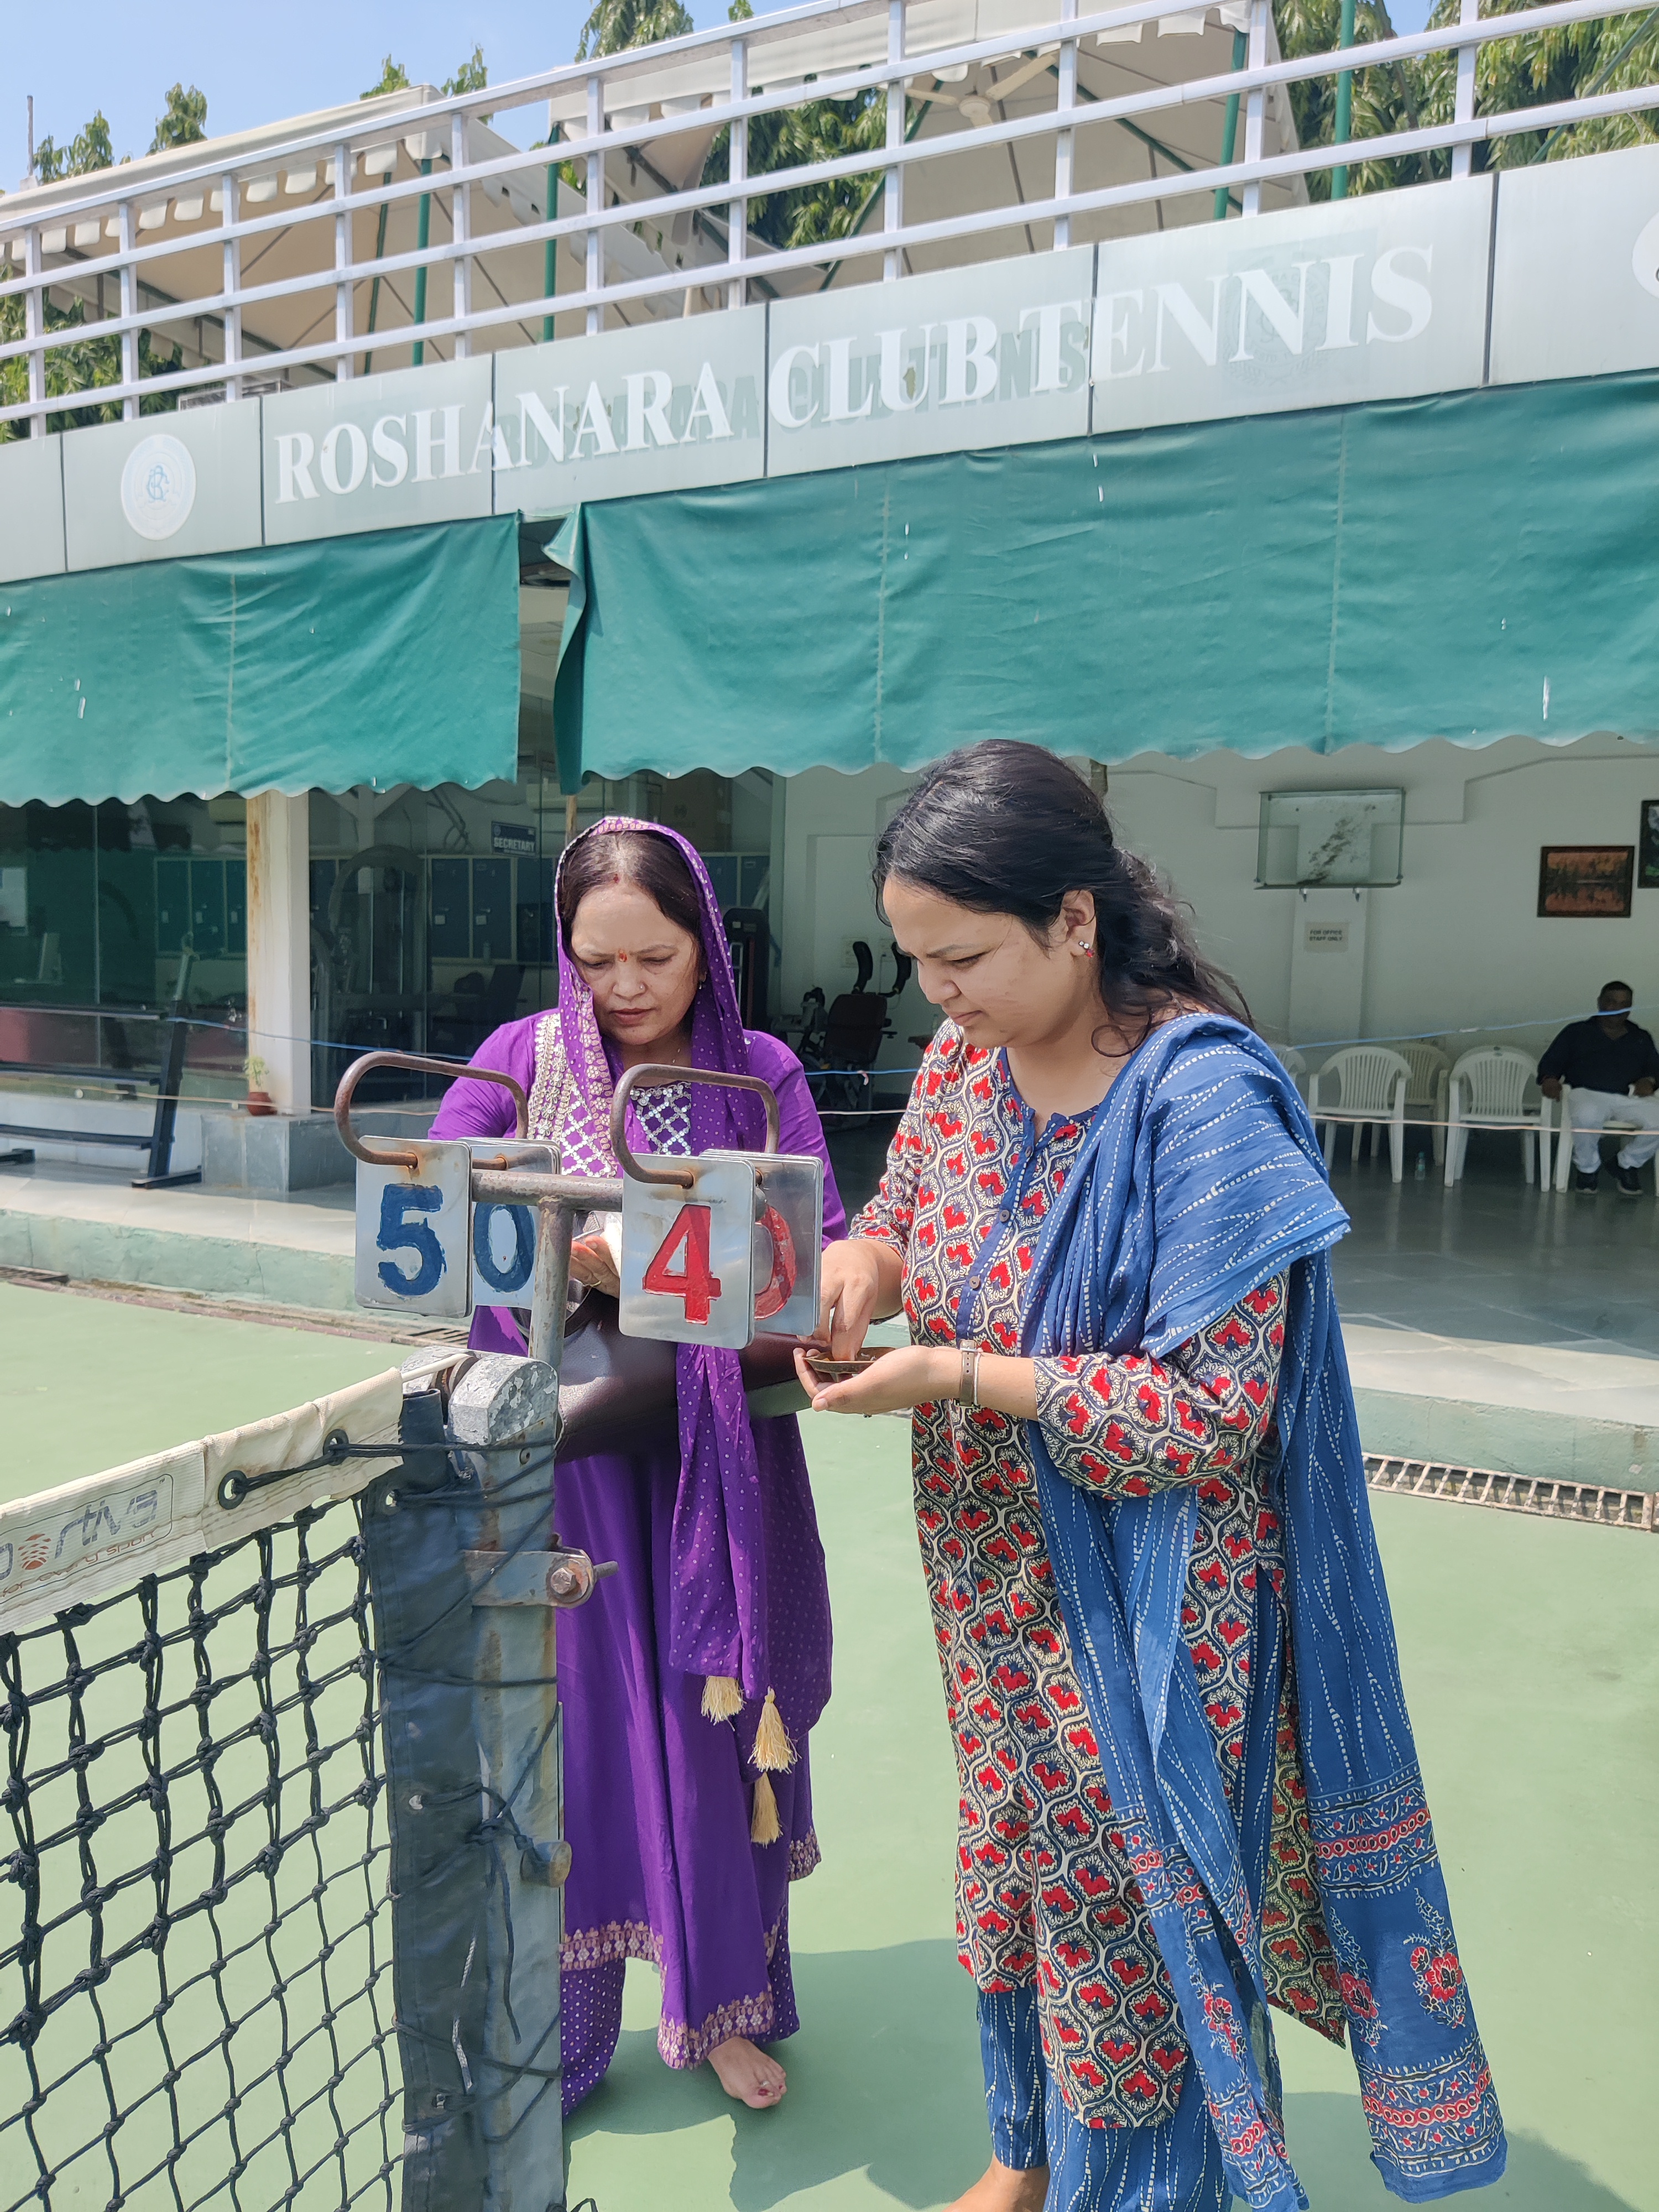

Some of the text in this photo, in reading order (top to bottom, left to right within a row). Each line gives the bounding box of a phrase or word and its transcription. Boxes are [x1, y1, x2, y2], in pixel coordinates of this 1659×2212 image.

[274, 362, 735, 505] ROSHANARA
[768, 315, 998, 429] CLUB
[1018, 244, 1435, 393] TENNIS
[493, 836, 535, 852] SECRETARY
[376, 1182, 447, 1297] 5
[642, 1203, 722, 1326] 4
